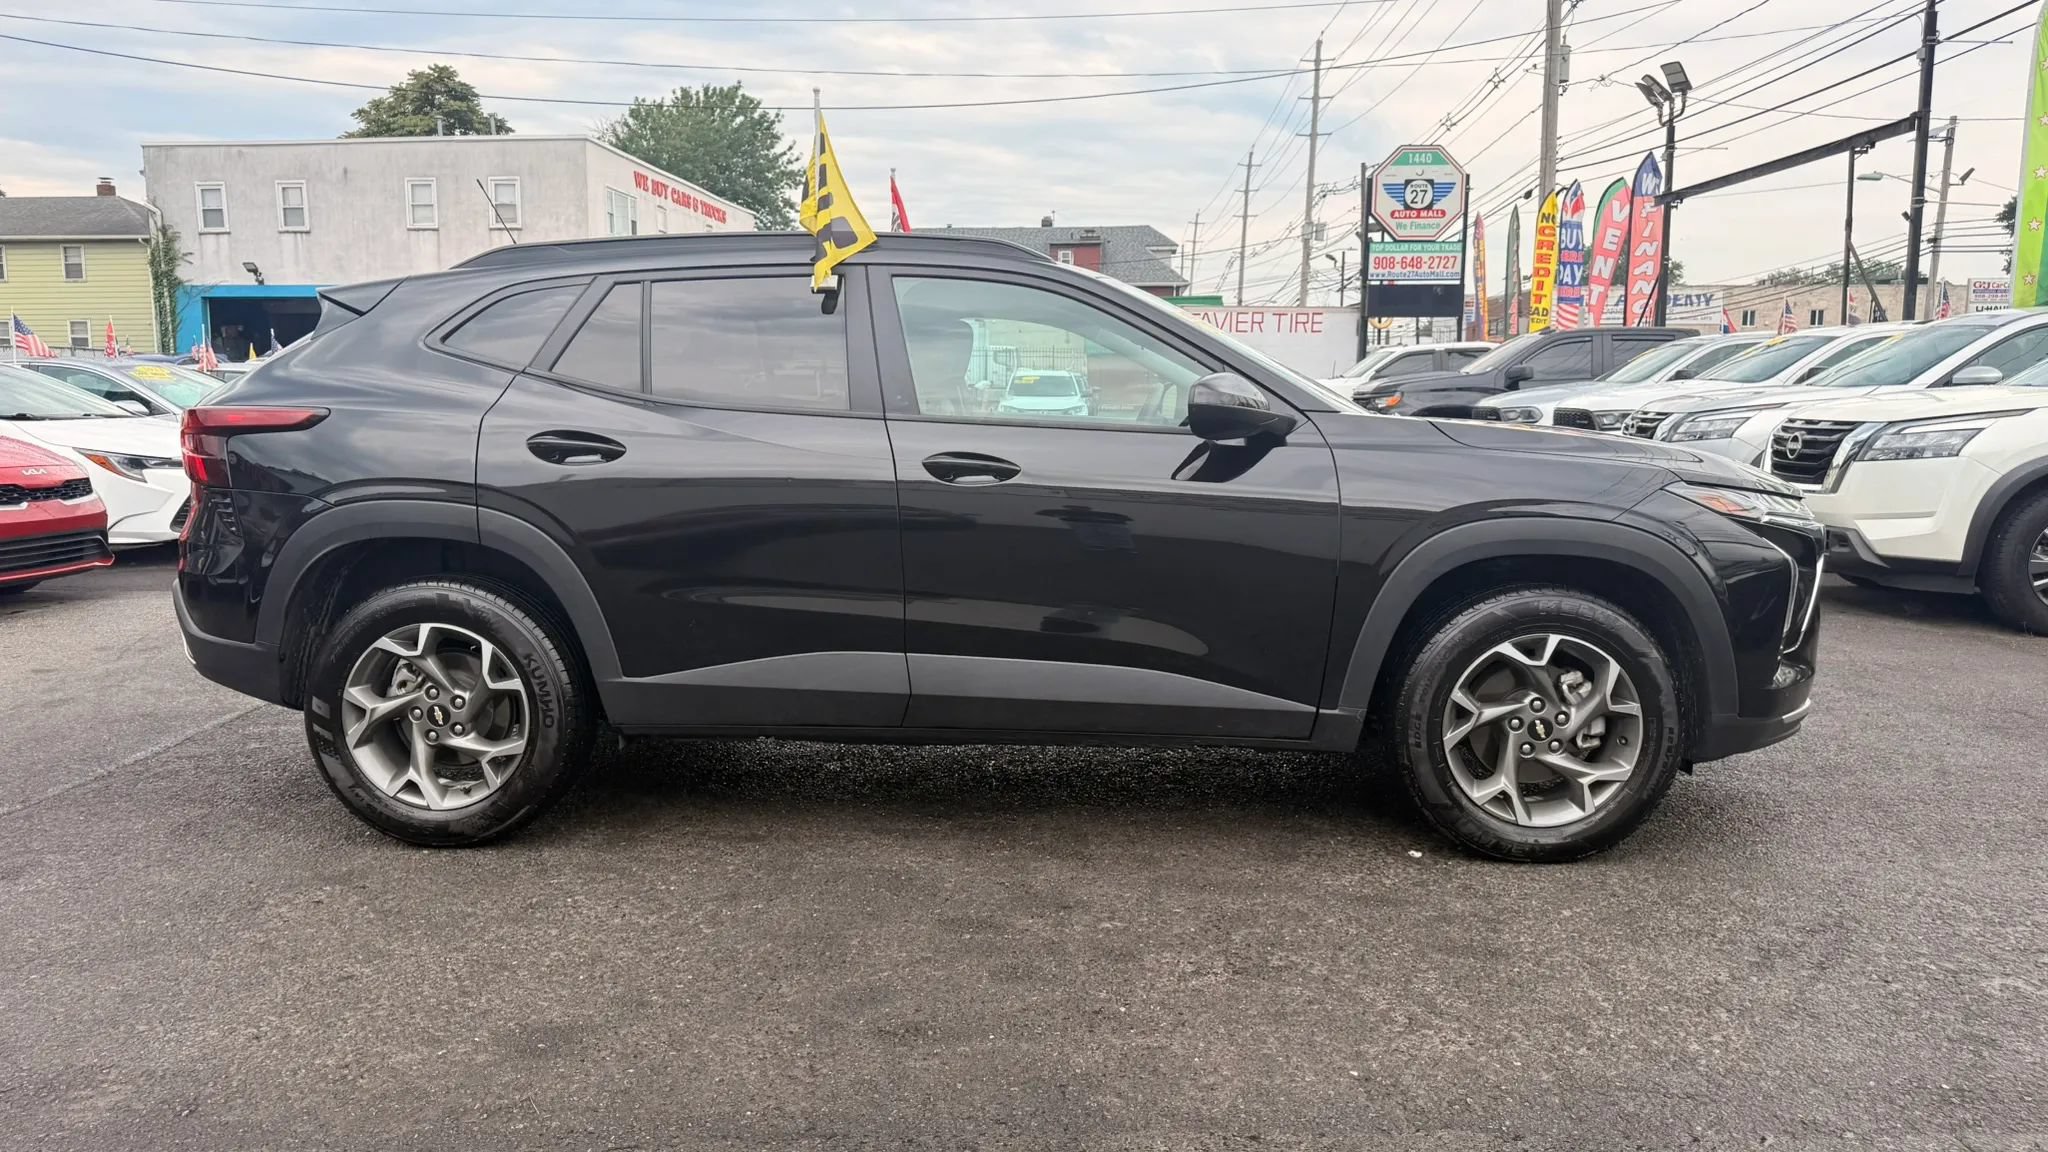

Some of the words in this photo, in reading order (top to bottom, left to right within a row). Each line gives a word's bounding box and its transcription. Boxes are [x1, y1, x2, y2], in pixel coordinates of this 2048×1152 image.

[1408, 153, 1432, 164] 1440
[633, 171, 649, 192] WE
[651, 178, 669, 200] BUY
[671, 187, 692, 209] CARS
[692, 196, 699, 213] &
[699, 199, 727, 224] TRUCKS
[1410, 189, 1428, 204] 27
[1393, 210, 1417, 218] AUTO
[1420, 209, 1444, 217] MALL
[1396, 222, 1408, 230] We
[1409, 221, 1441, 230] Finance
[1385, 244, 1409, 252] DOLLAR
[1373, 256, 1457, 269] 908-648-2727
[1533, 225, 1556, 304] CREDIT
[1192, 312, 1265, 333] AVIER
[1272, 312, 1324, 333] TIRE
[522, 653, 554, 729] KUMHO
